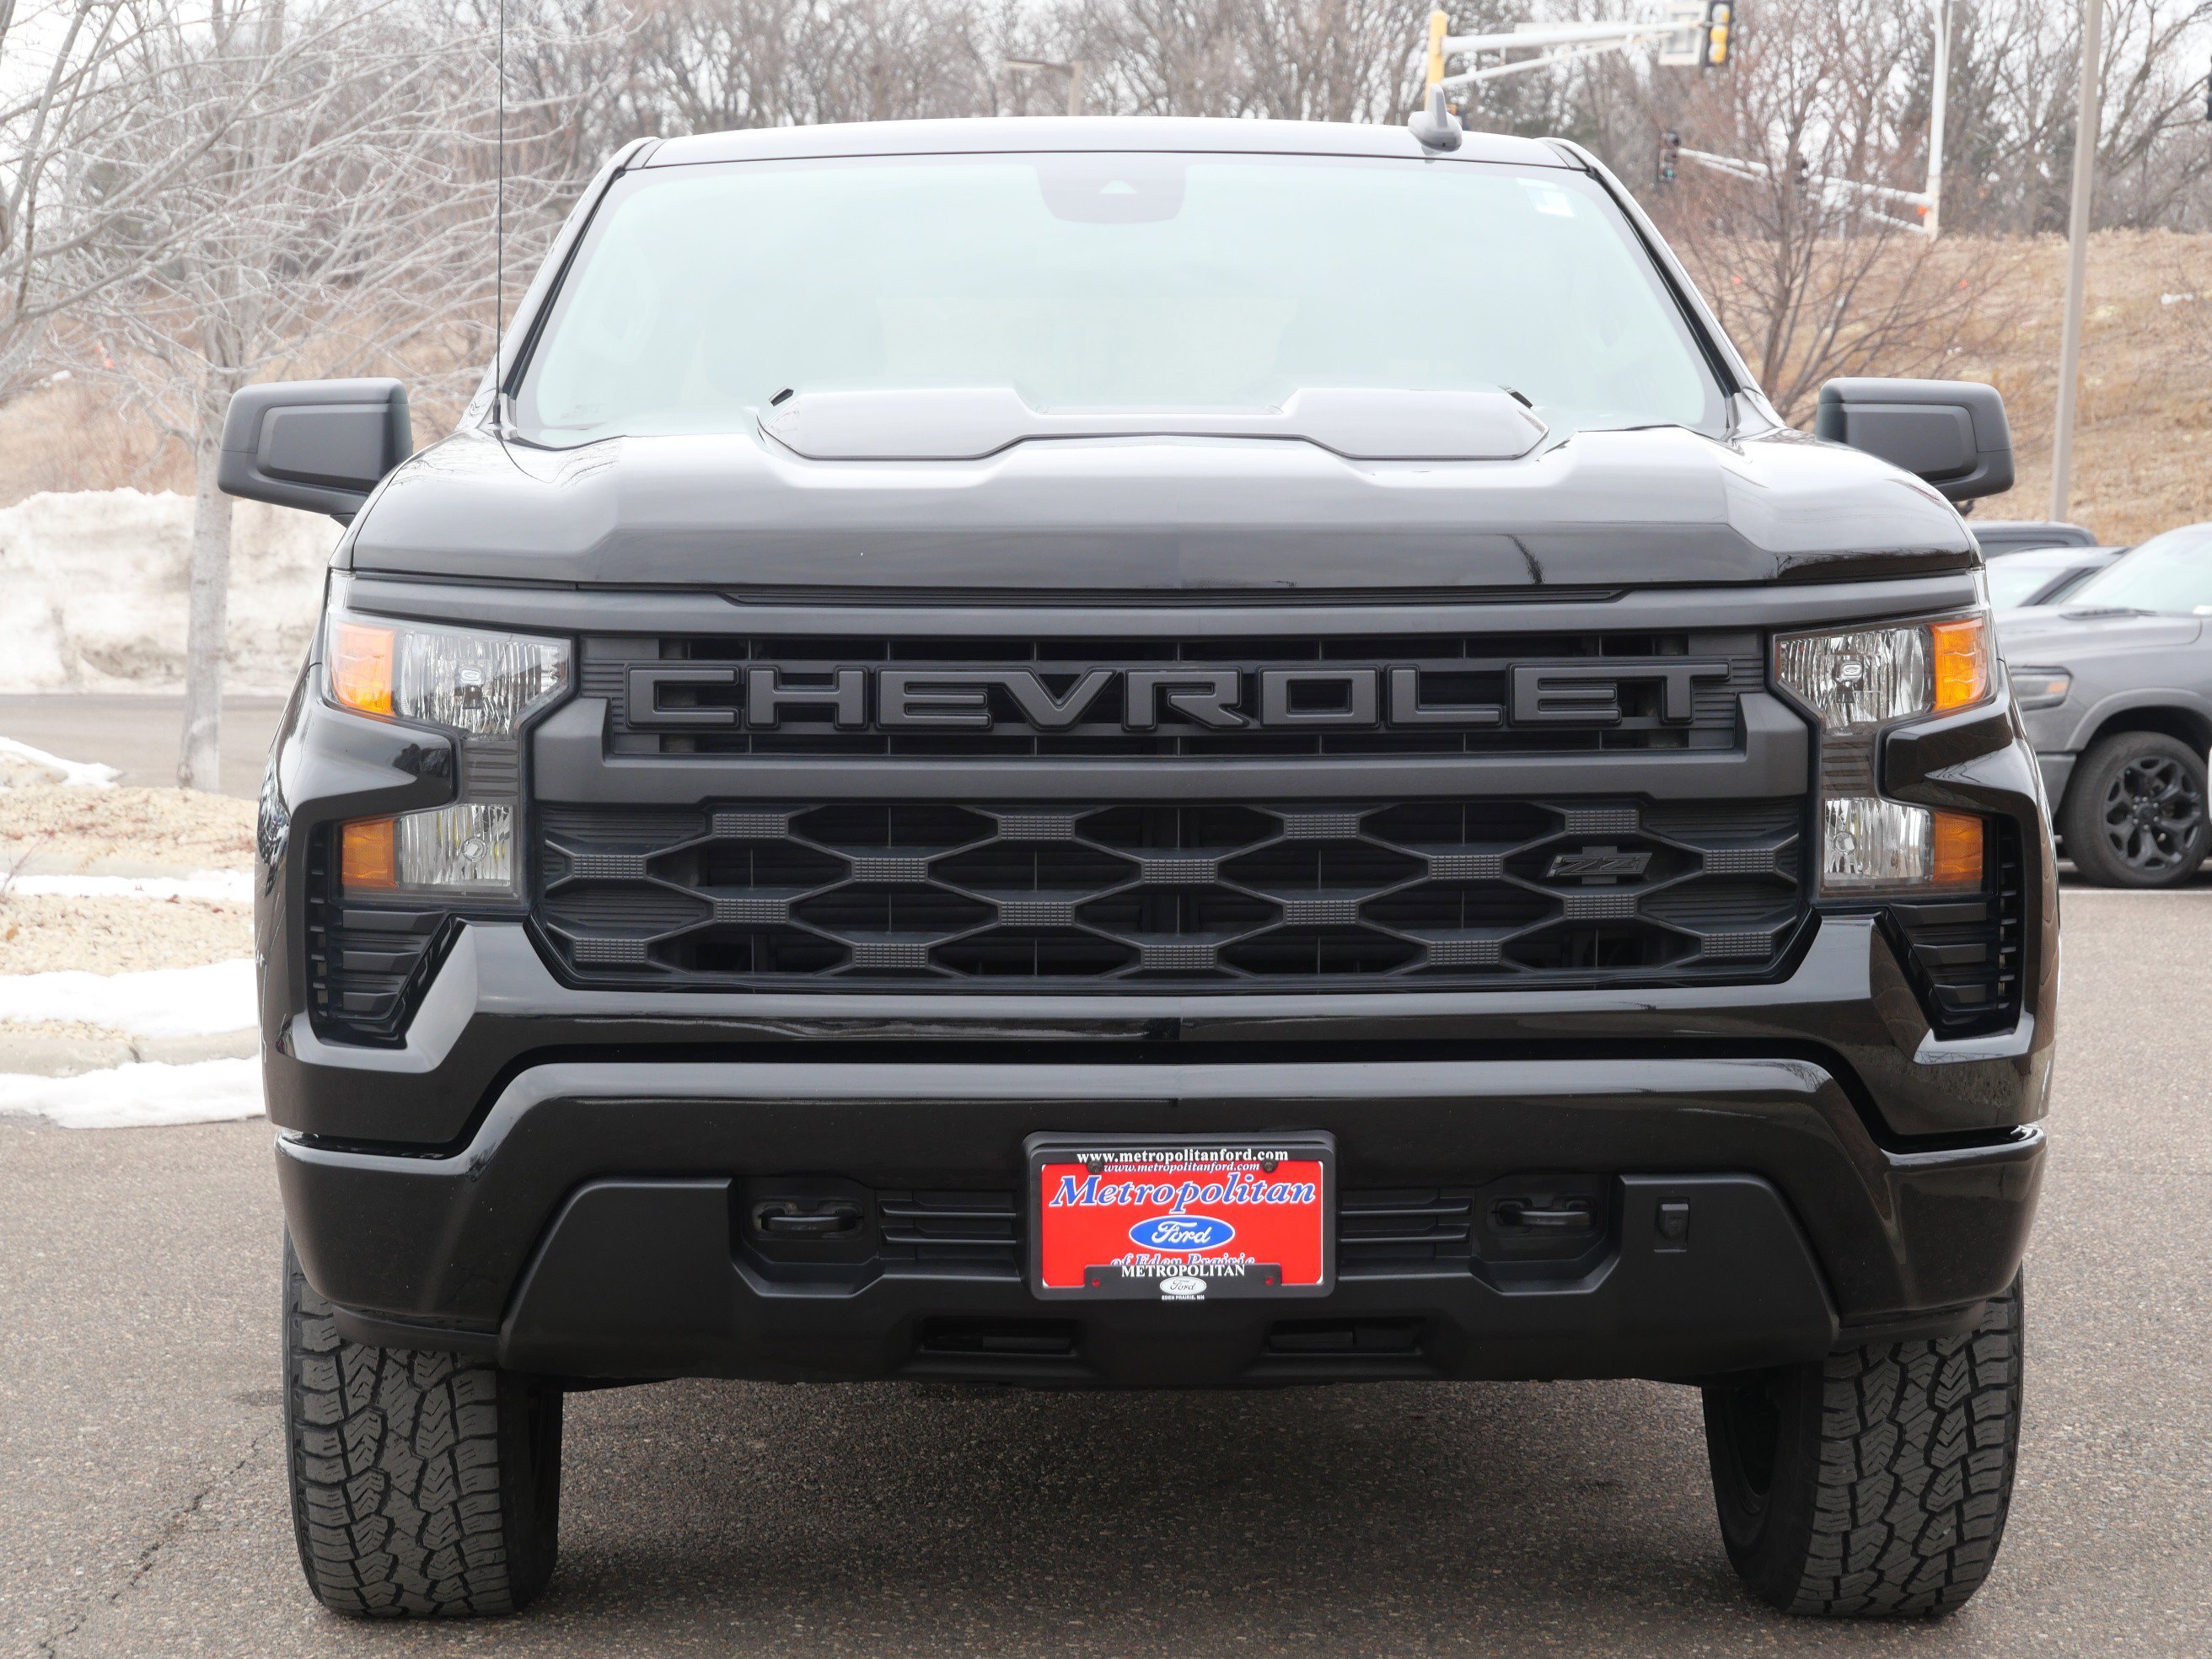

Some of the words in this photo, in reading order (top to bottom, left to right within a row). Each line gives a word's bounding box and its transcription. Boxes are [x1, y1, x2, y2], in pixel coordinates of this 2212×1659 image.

[625, 662, 1731, 732] CHEVROLET
[1076, 1148, 1289, 1164] www.metropolitanford.com
[1103, 1161, 1260, 1174] www.metropolitanford.com
[1049, 1172, 1316, 1214] Metropolitan
[1151, 1221, 1211, 1243] Ford
[1121, 1264, 1246, 1278] METROPOLITAN
[1170, 1280, 1196, 1290] Ford
